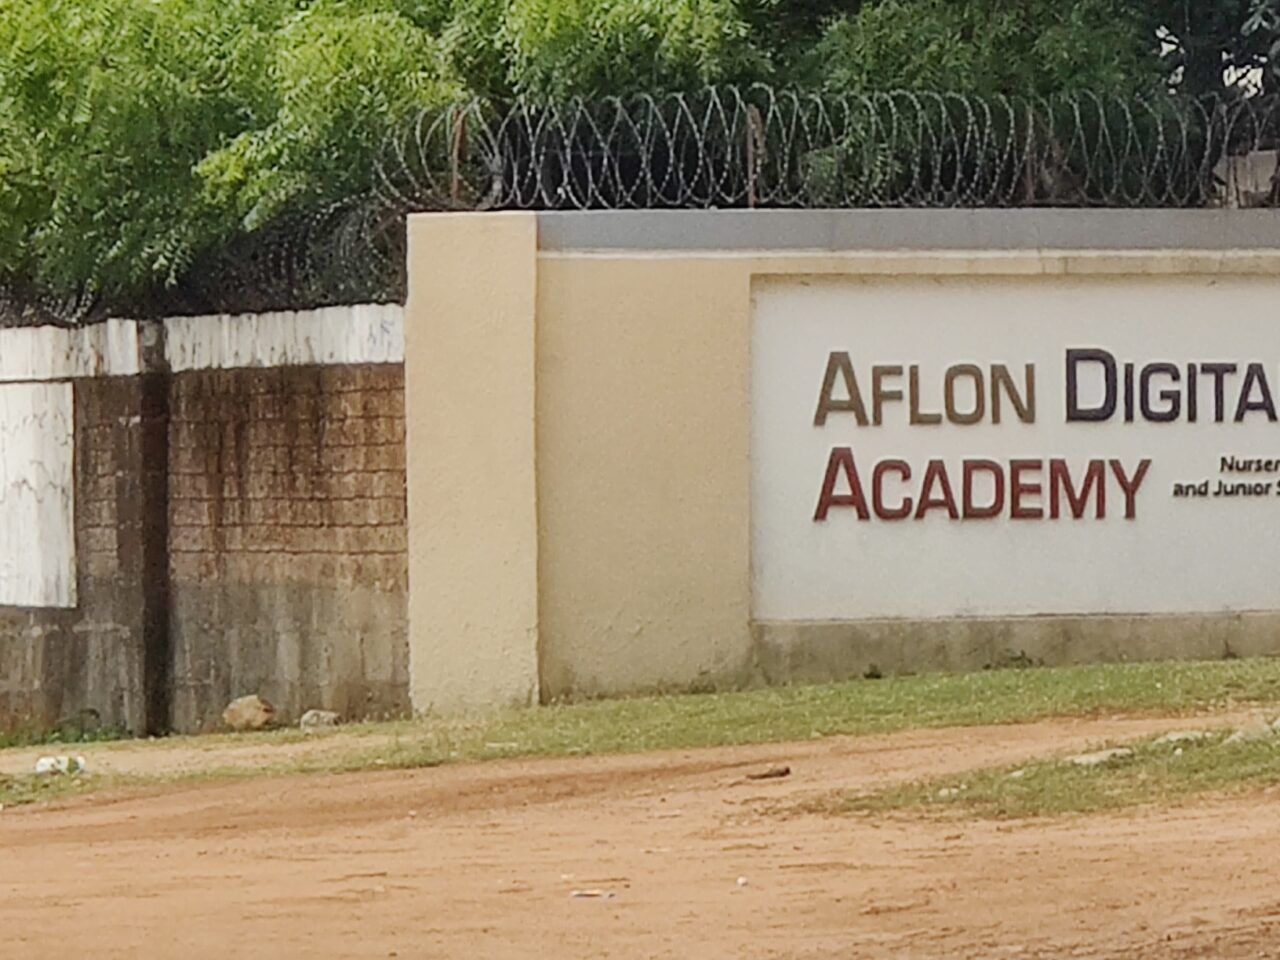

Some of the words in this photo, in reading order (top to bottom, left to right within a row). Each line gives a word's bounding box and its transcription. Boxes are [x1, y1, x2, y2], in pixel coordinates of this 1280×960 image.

[813, 351, 1036, 426] AFLON
[813, 446, 1152, 521] ACADEMY
[1173, 481, 1209, 497] and
[1213, 481, 1272, 497] Junior
